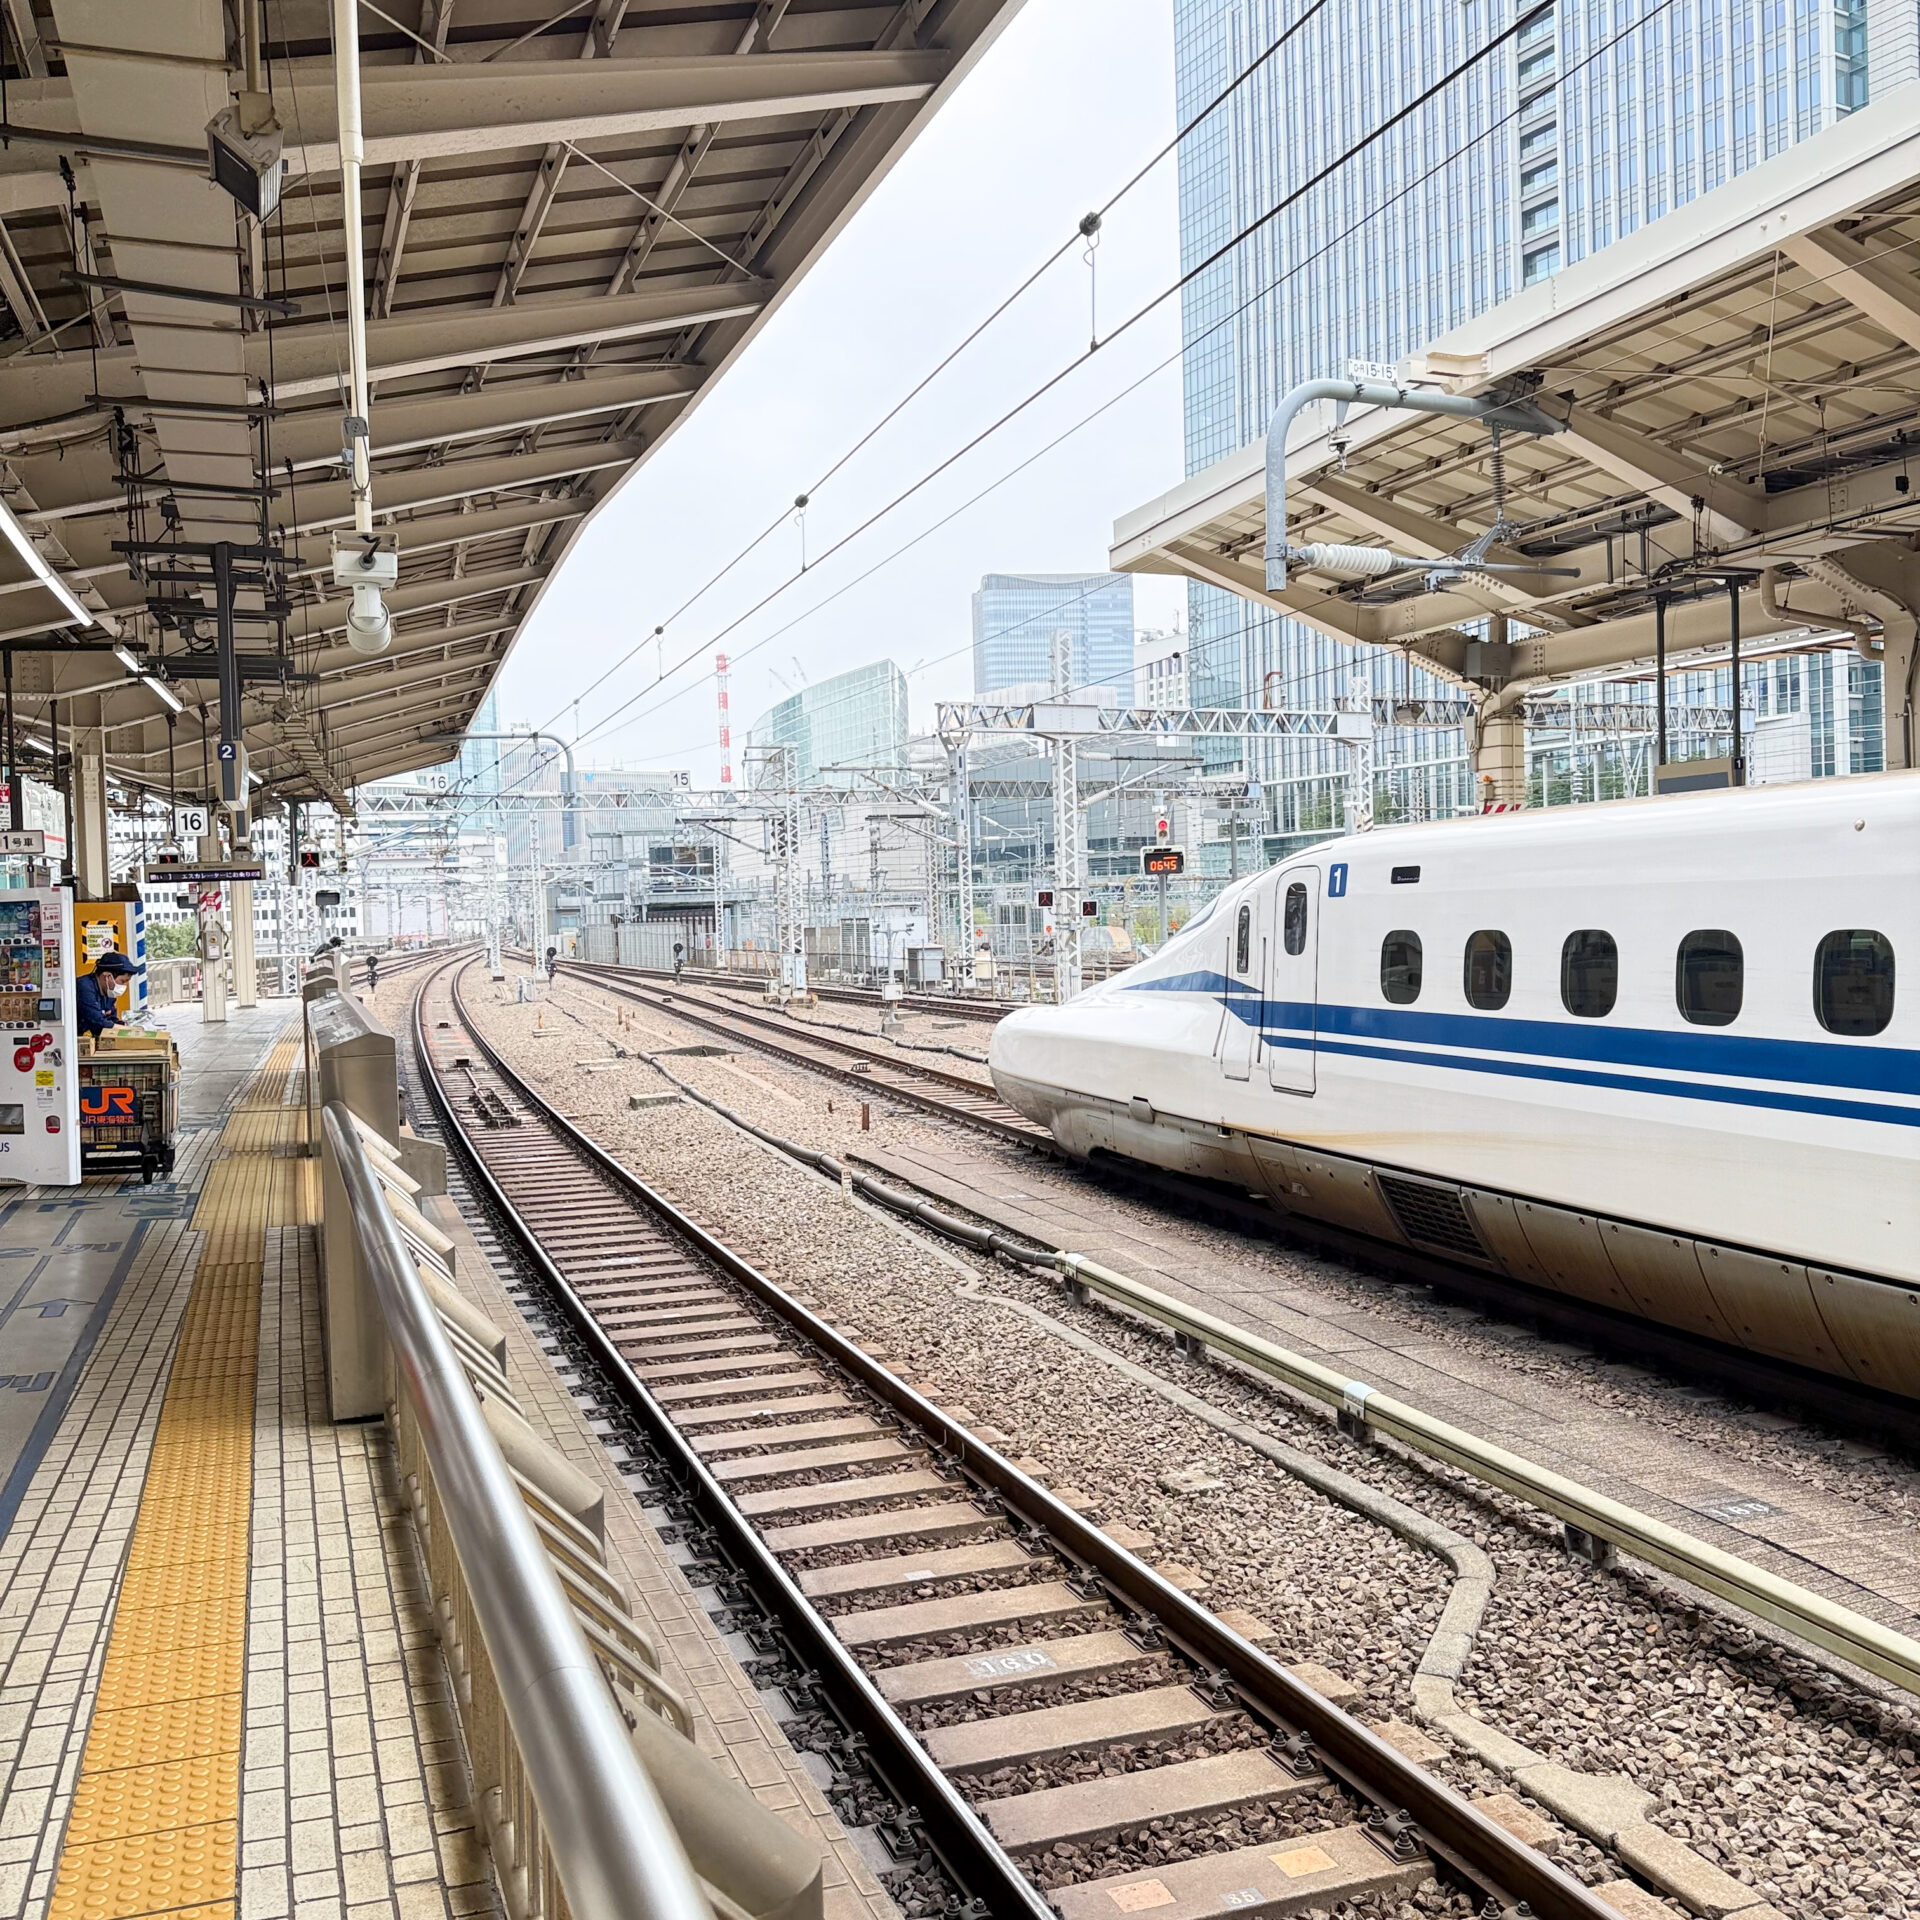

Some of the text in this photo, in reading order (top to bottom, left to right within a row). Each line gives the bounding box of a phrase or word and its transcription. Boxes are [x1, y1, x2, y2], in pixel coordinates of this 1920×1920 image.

[221, 745, 233, 758] 2
[1737, 760, 1742, 769] 1
[430, 776, 447, 789] 16
[673, 773, 688, 785] 15
[180, 813, 202, 831] 16
[1150, 861, 1177, 871] 0645
[1334, 868, 1341, 892] 1
[81, 1087, 134, 1114] JR
